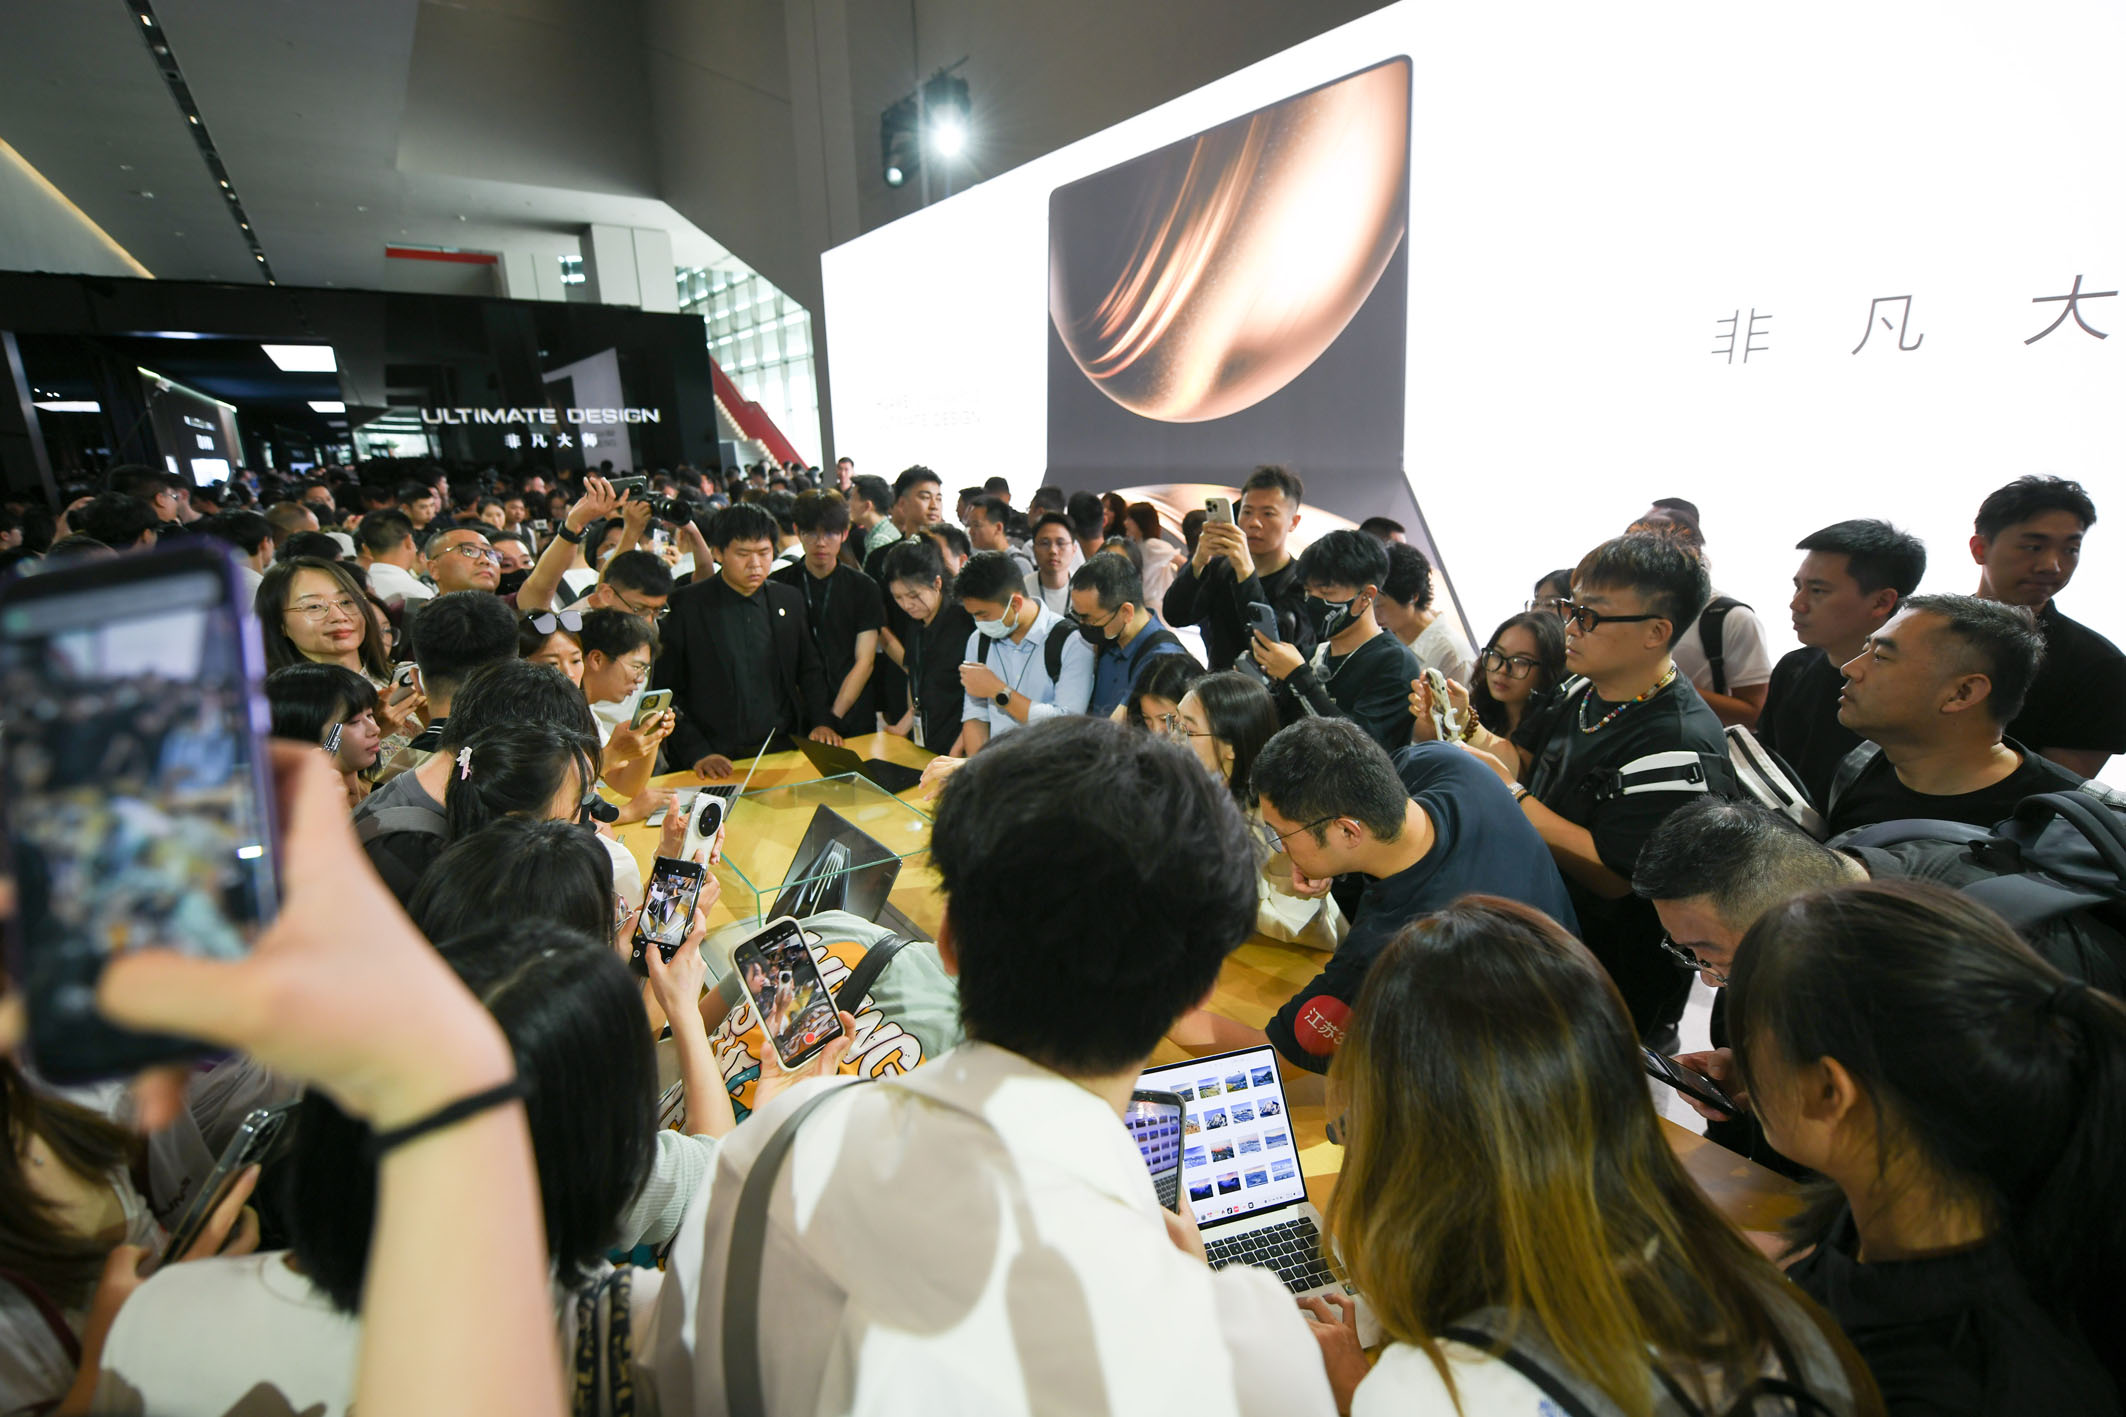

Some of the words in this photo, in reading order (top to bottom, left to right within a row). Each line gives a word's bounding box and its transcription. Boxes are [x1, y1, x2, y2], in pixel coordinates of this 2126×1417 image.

[1711, 274, 2119, 365] 非凡大
[421, 407, 558, 424] ULTIMATE
[566, 407, 660, 424] DESIGN
